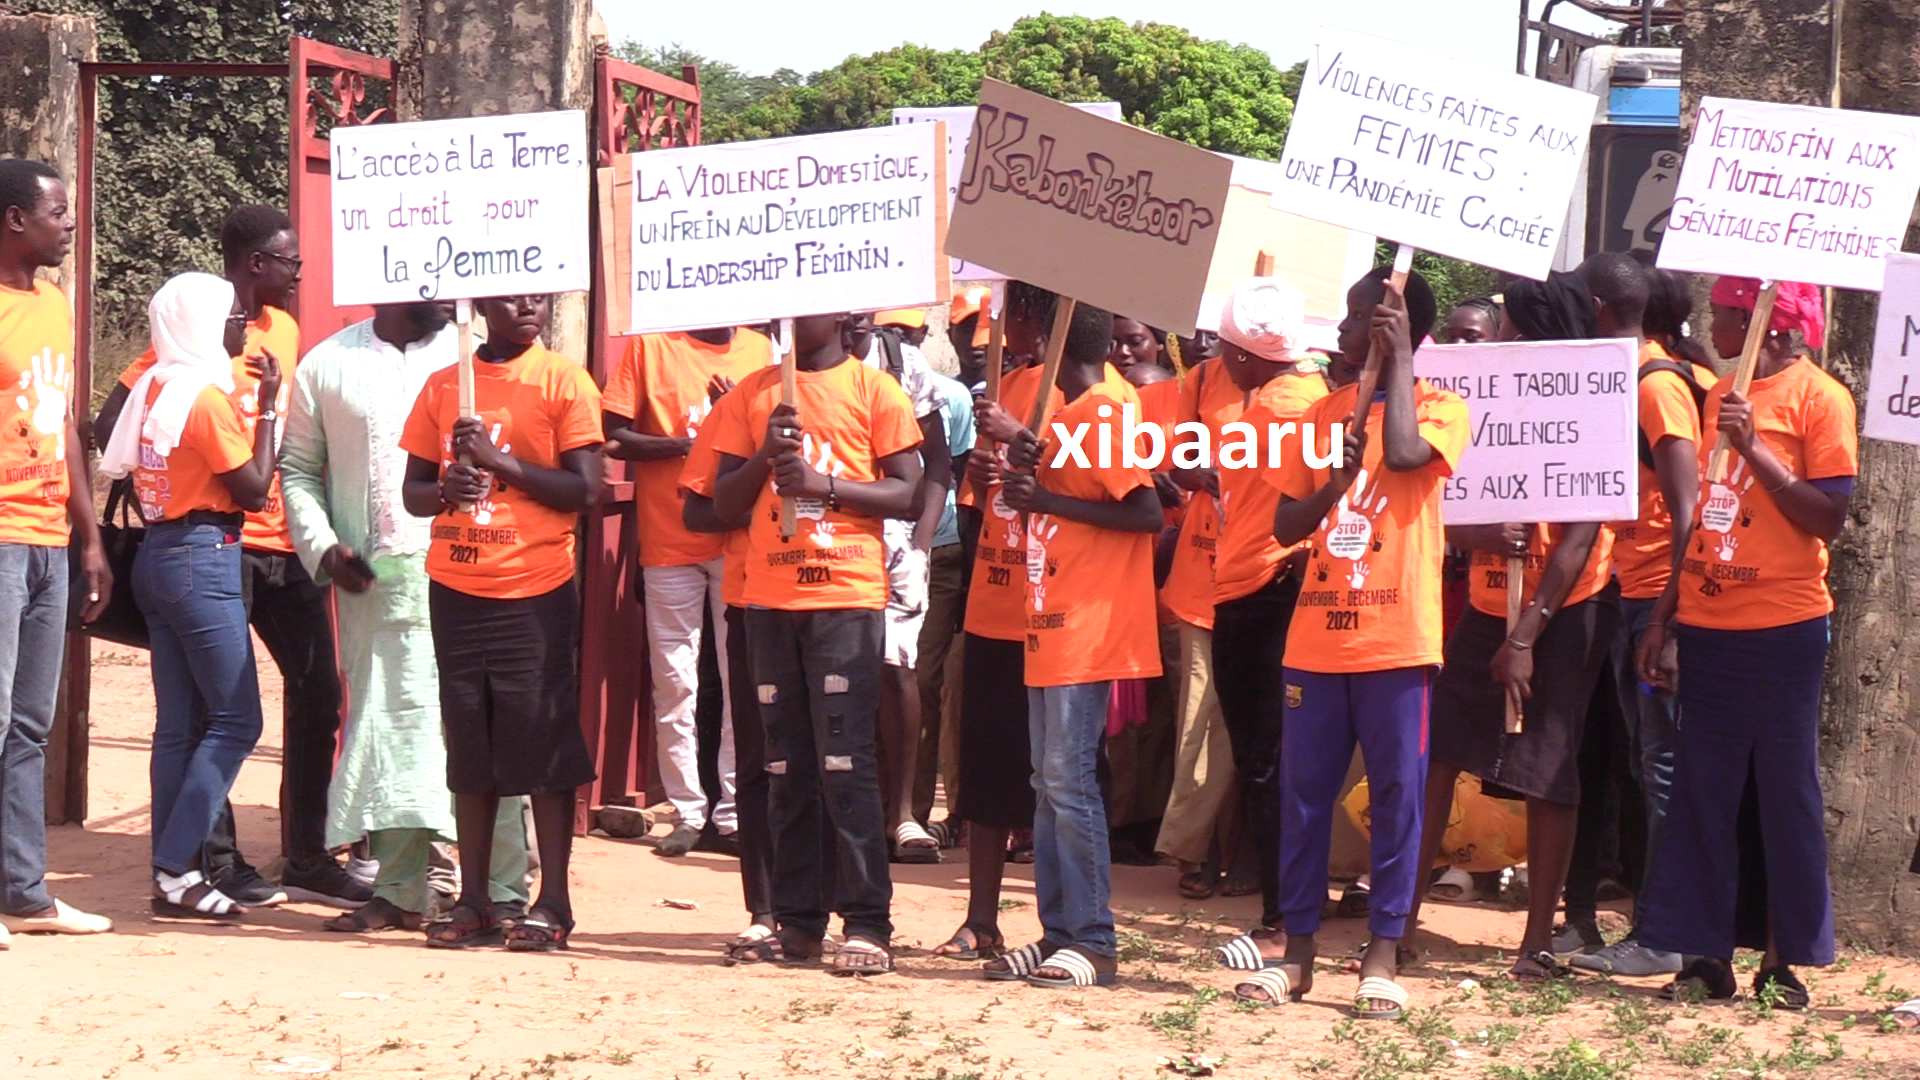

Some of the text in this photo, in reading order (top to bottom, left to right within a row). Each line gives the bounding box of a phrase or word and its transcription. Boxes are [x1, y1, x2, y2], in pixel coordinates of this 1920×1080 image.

[1314, 43, 1579, 156] VIOLENCES FAITES AUX
[470, 134, 494, 169] la
[503, 131, 582, 169] Terre,
[1353, 114, 1498, 182] FEMMES
[1787, 127, 1835, 160] FIN
[1846, 141, 1897, 170] AUX
[1285, 158, 1325, 187] UNE
[1707, 156, 1874, 210] MUTILATIONS
[341, 190, 539, 236] un droit pour
[383, 245, 410, 284] la
[1477, 374, 1500, 399] LE
[1513, 372, 1579, 397] TABOU
[1587, 371, 1627, 395] SUR
[1471, 412, 1579, 447] VIOLENCES
[1480, 474, 1528, 500] AUX
[1544, 462, 1625, 497] FEMMES
[1710, 497, 1736, 509] STOP
[468, 527, 518, 545] DECEMBRE
[1336, 523, 1366, 535] STOP
[450, 544, 478, 564] 2021
[797, 565, 832, 584] 2021
[987, 566, 1010, 586] 2021
[1347, 588, 1398, 607] DECEMBRE
[1326, 610, 1359, 630] 2021
